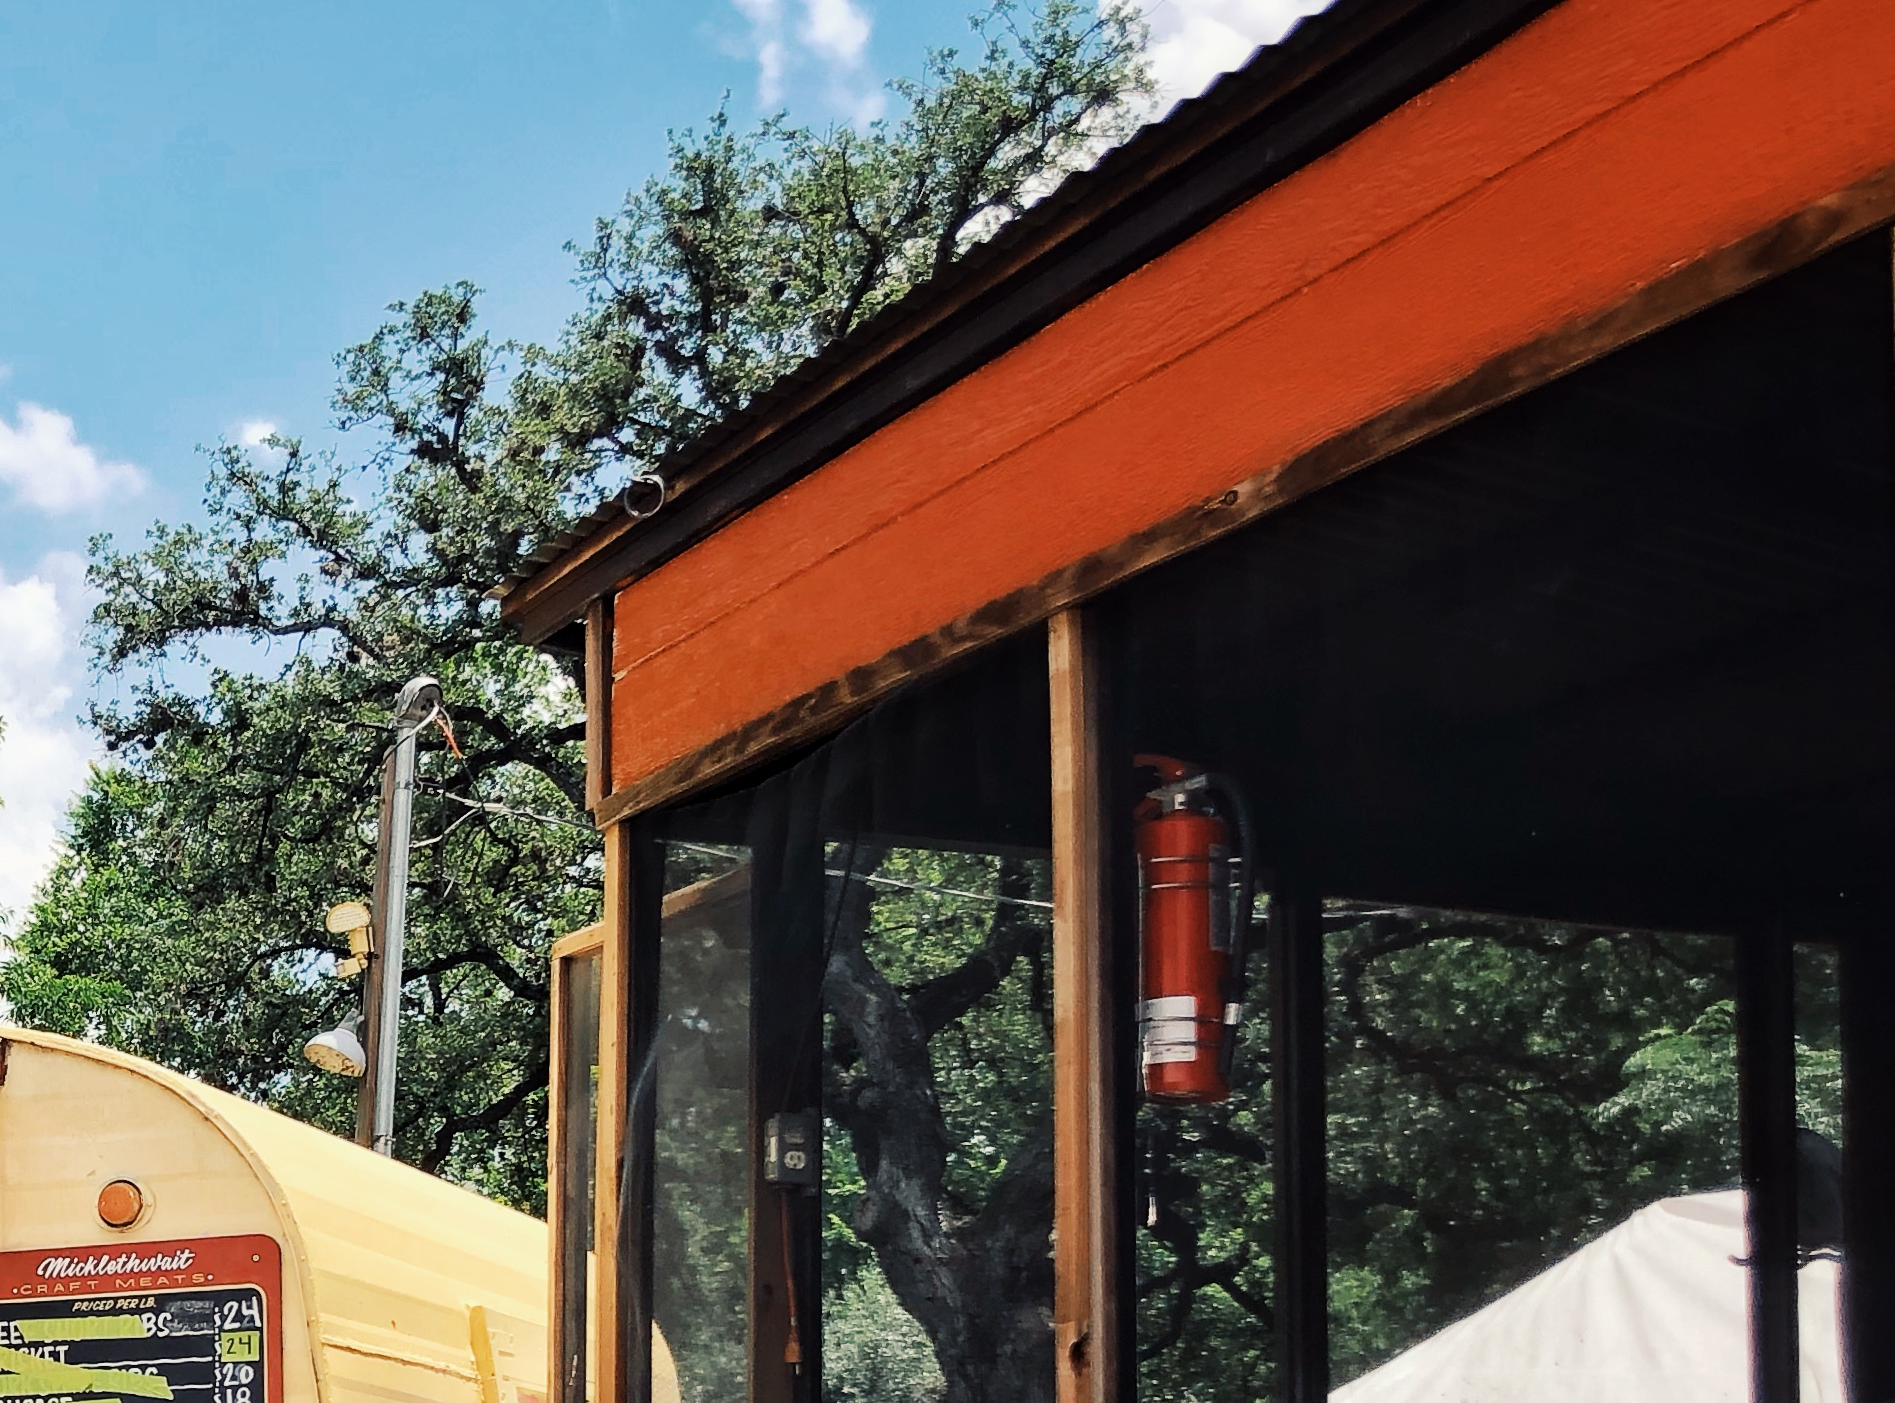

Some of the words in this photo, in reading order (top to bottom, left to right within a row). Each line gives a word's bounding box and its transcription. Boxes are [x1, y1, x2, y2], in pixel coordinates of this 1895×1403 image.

[36, 1248, 196, 1279] Micklethwait
[19, 1279, 100, 1296] CRAFT
[115, 1273, 205, 1289] MEATS
[72, 1300, 114, 1312] PRICED
[115, 1298, 137, 1310] PER
